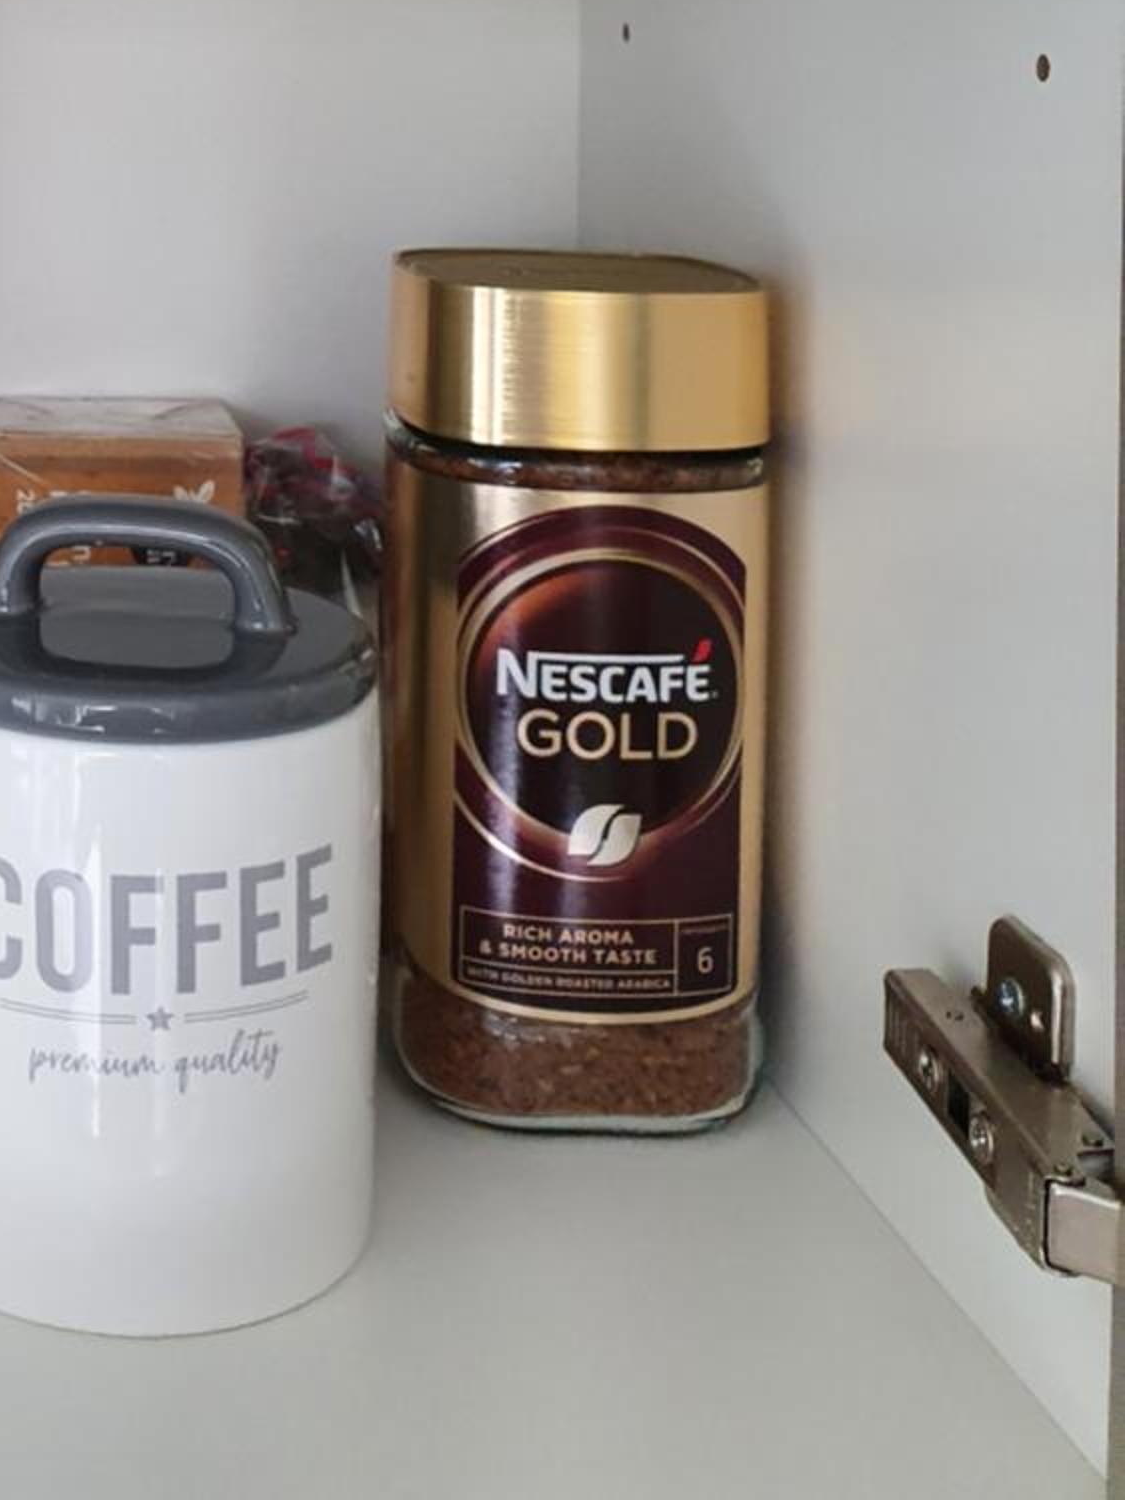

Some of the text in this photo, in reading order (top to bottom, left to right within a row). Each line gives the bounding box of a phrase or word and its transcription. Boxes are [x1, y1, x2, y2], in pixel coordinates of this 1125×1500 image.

[496, 639, 712, 703] NESCAFÉ
[517, 708, 698, 760] GOLD
[479, 940, 658, 966] & SMOOTH TASTE
[502, 923, 635, 946] RICH AROMA
[697, 947, 714, 974] 6
[28, 1027, 282, 1095] premium quality
